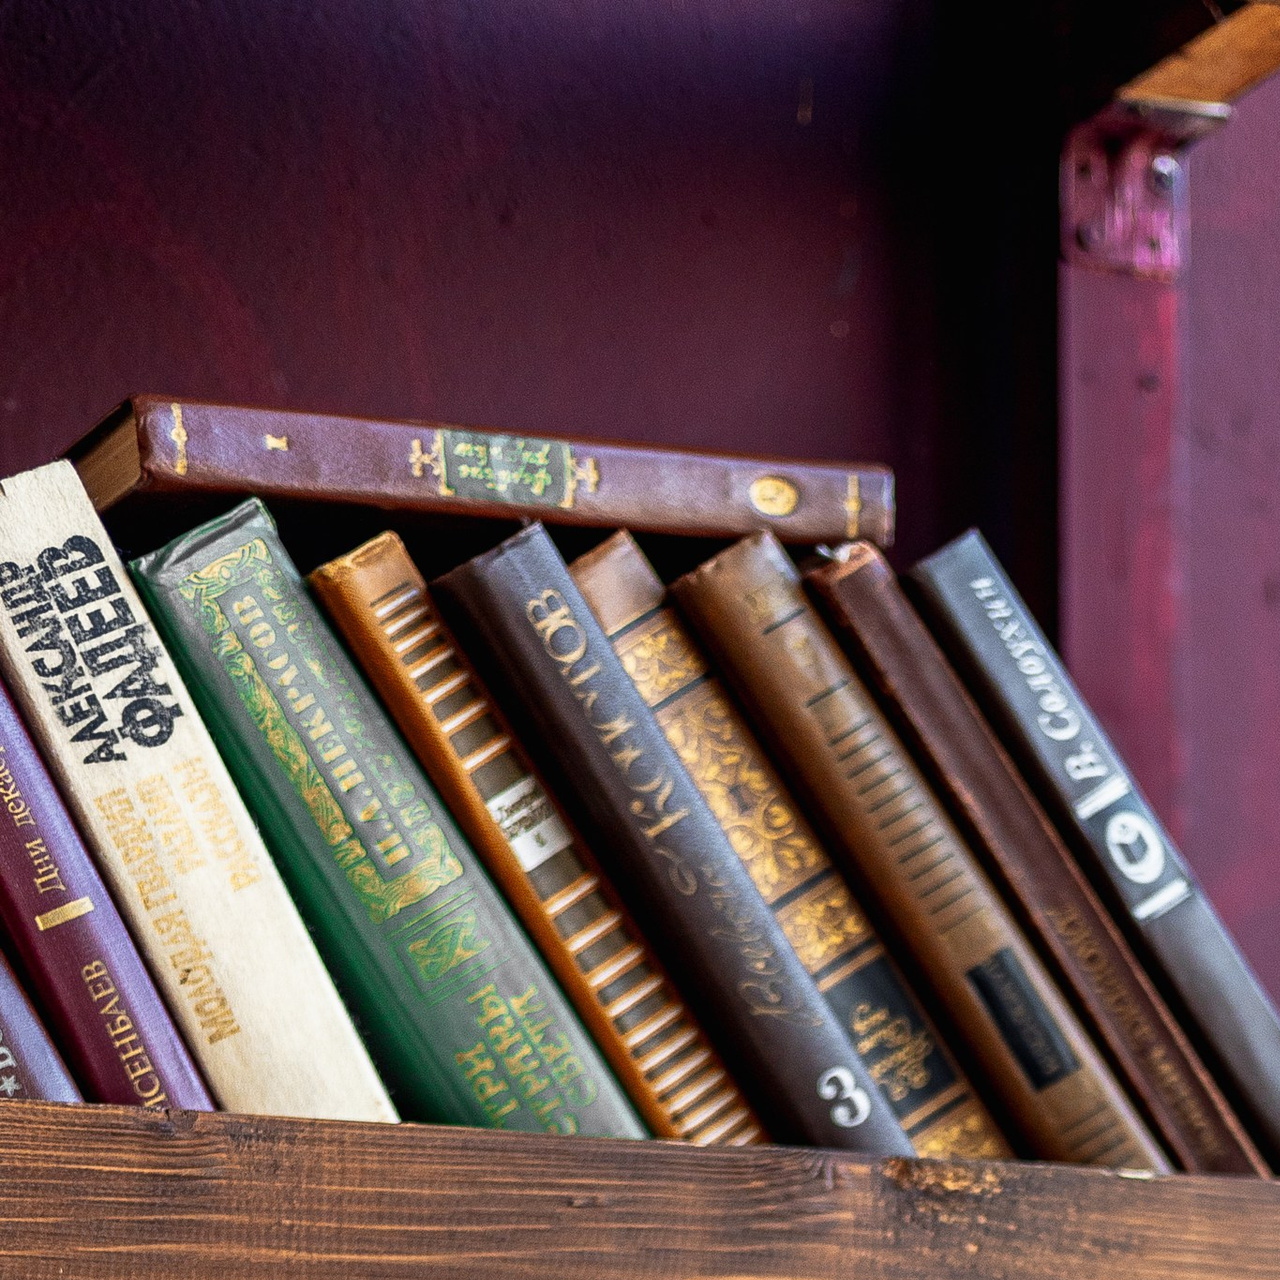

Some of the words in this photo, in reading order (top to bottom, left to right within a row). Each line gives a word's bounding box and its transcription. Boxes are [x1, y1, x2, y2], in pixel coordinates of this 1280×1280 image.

[0, 555, 127, 768] АЛЕКСАНДР
[35, 532, 182, 749] ФАДЕЕВ
[968, 575, 1084, 738] Солоухин
[172, 754, 264, 892] РАССКАЗЫ
[1063, 740, 1109, 783] В.
[20, 836, 66, 892] Дни
[92, 784, 180, 916] ГВАРДИЯ
[149, 906, 242, 1047] МОЛОДАЯ
[452, 1042, 522, 1125] ТРИ
[506, 983, 602, 1111] СВЕТА
[817, 1063, 874, 1133] 3
